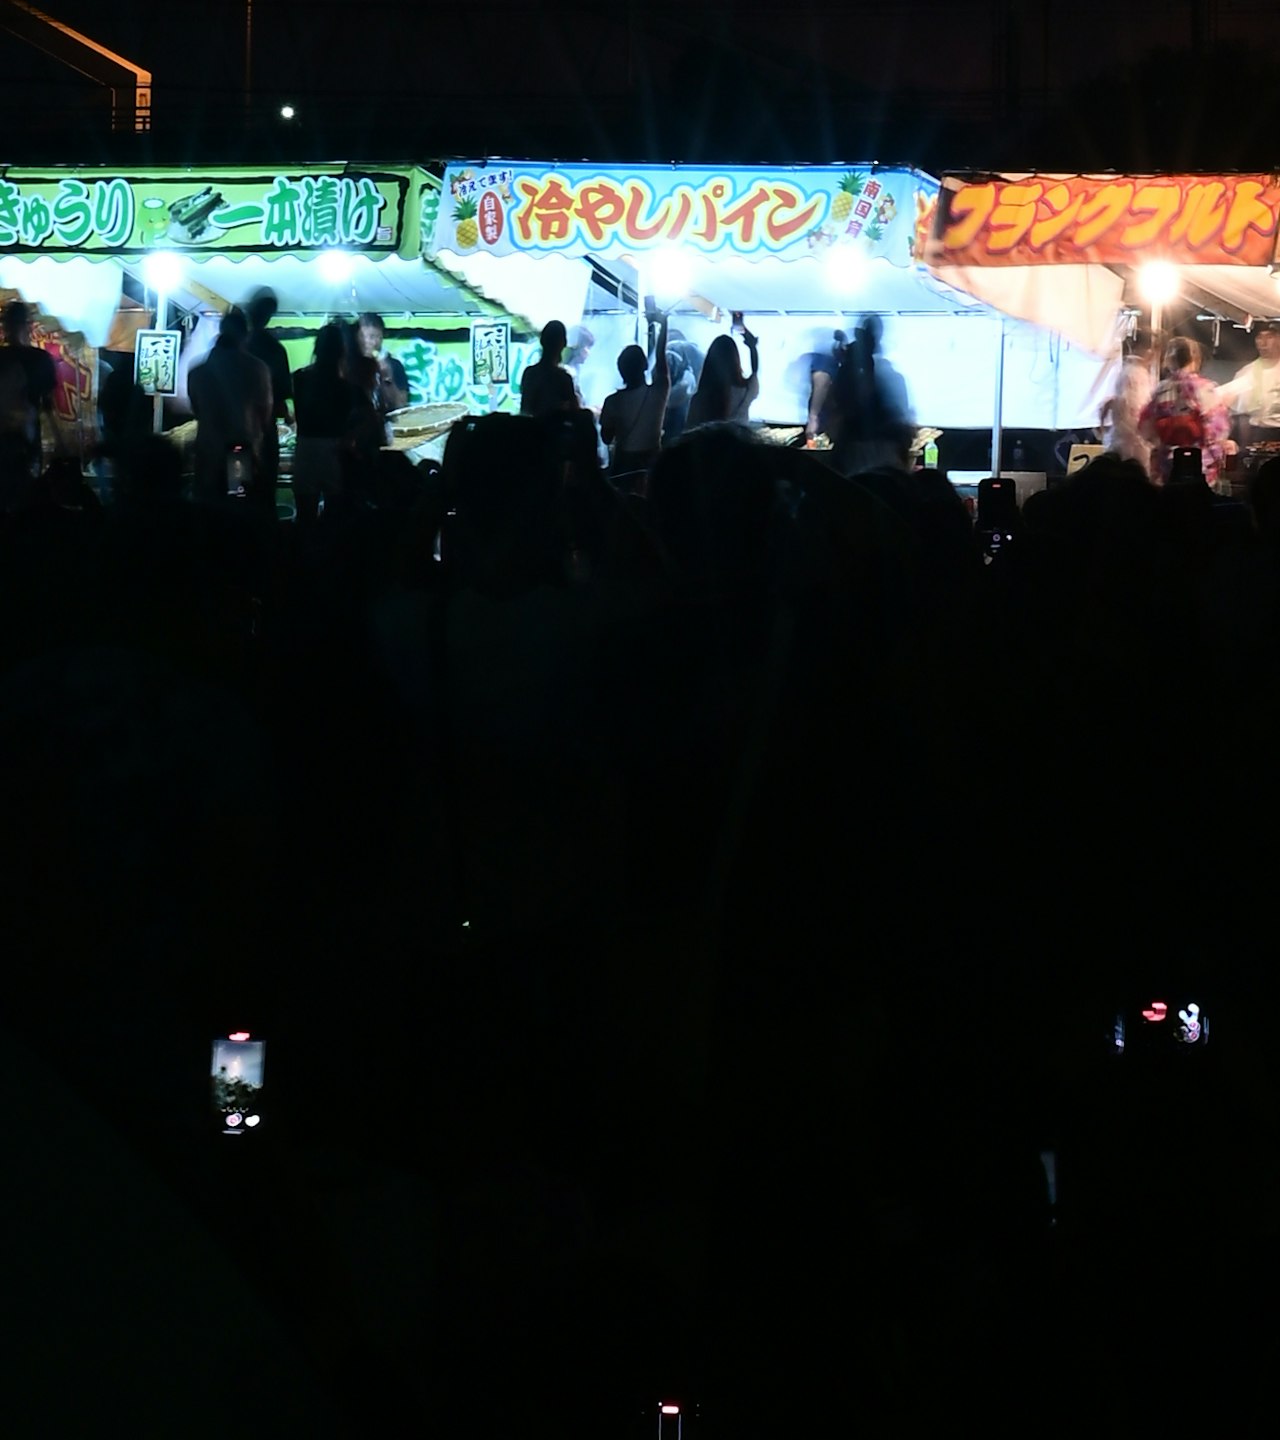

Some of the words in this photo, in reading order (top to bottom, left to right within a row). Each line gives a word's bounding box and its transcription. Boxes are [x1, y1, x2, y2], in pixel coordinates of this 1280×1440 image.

[212, 178, 382, 245] 一本漬け
[459, 170, 513, 196] 冷えてます!
[518, 181, 820, 241] 冷やしパイン
[483, 196, 498, 240] 自家製
[944, 181, 1276, 251] フランクフルト
